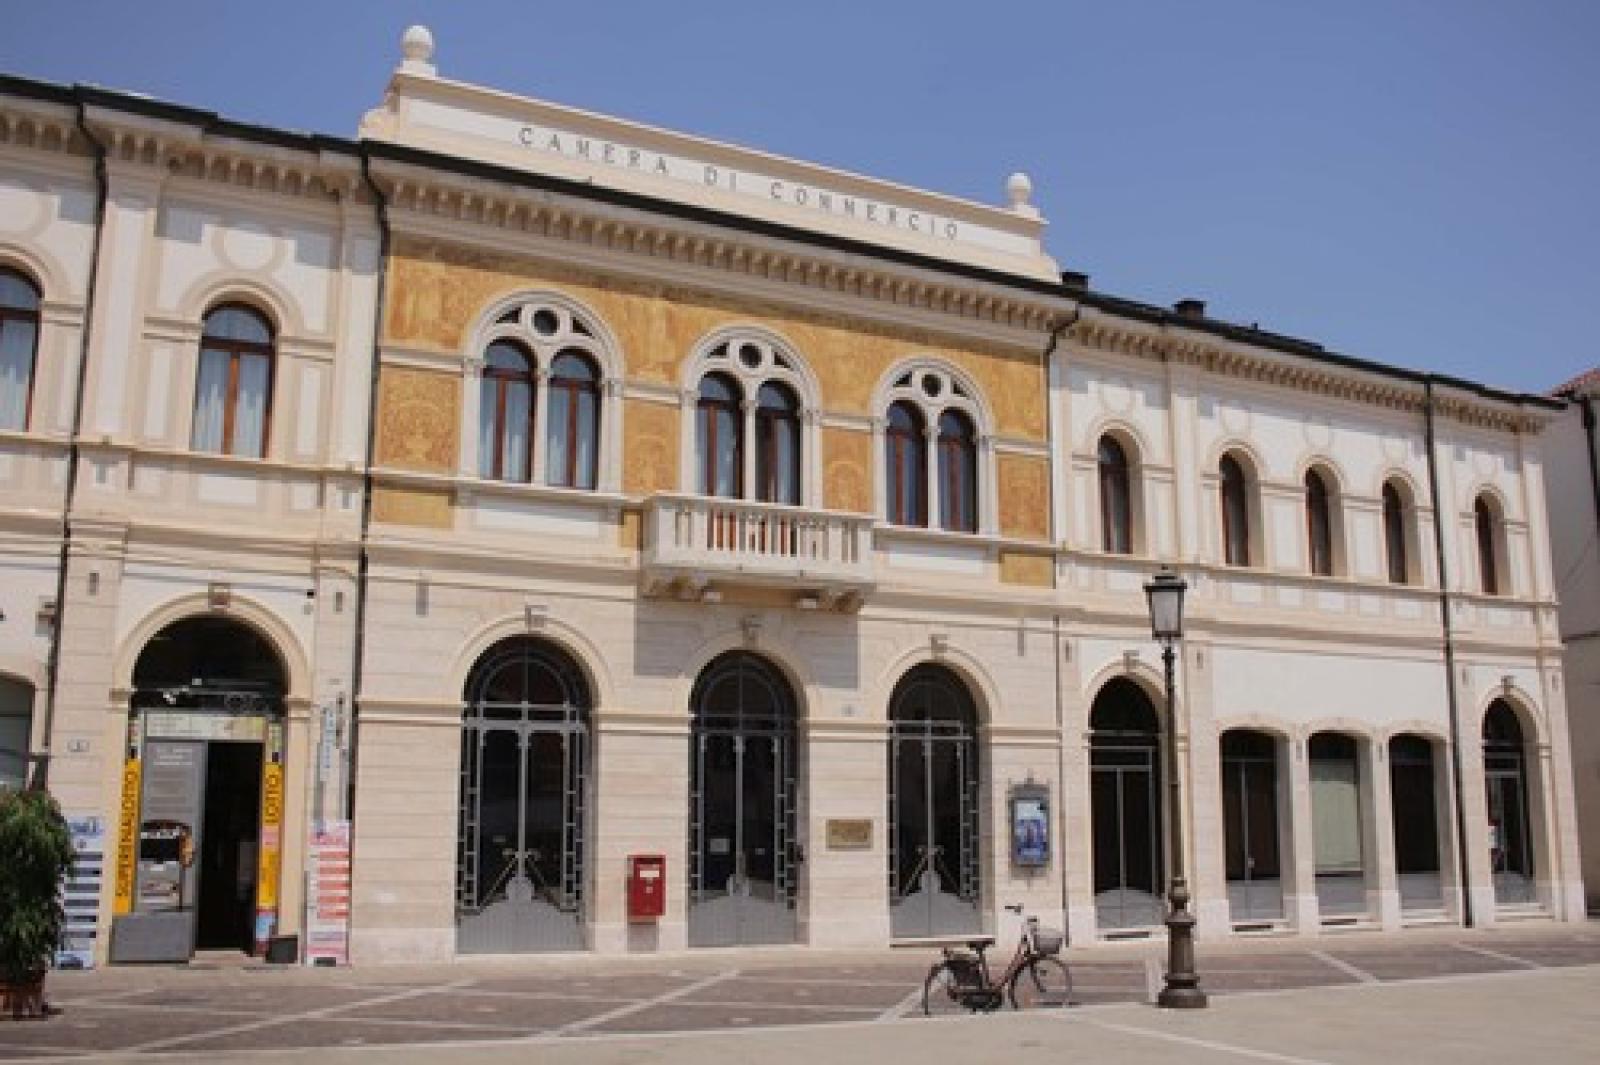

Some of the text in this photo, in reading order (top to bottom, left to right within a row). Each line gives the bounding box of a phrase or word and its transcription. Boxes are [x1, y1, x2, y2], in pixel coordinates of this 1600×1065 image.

[518, 127, 958, 240] CAMERA DI COMMERCIO
